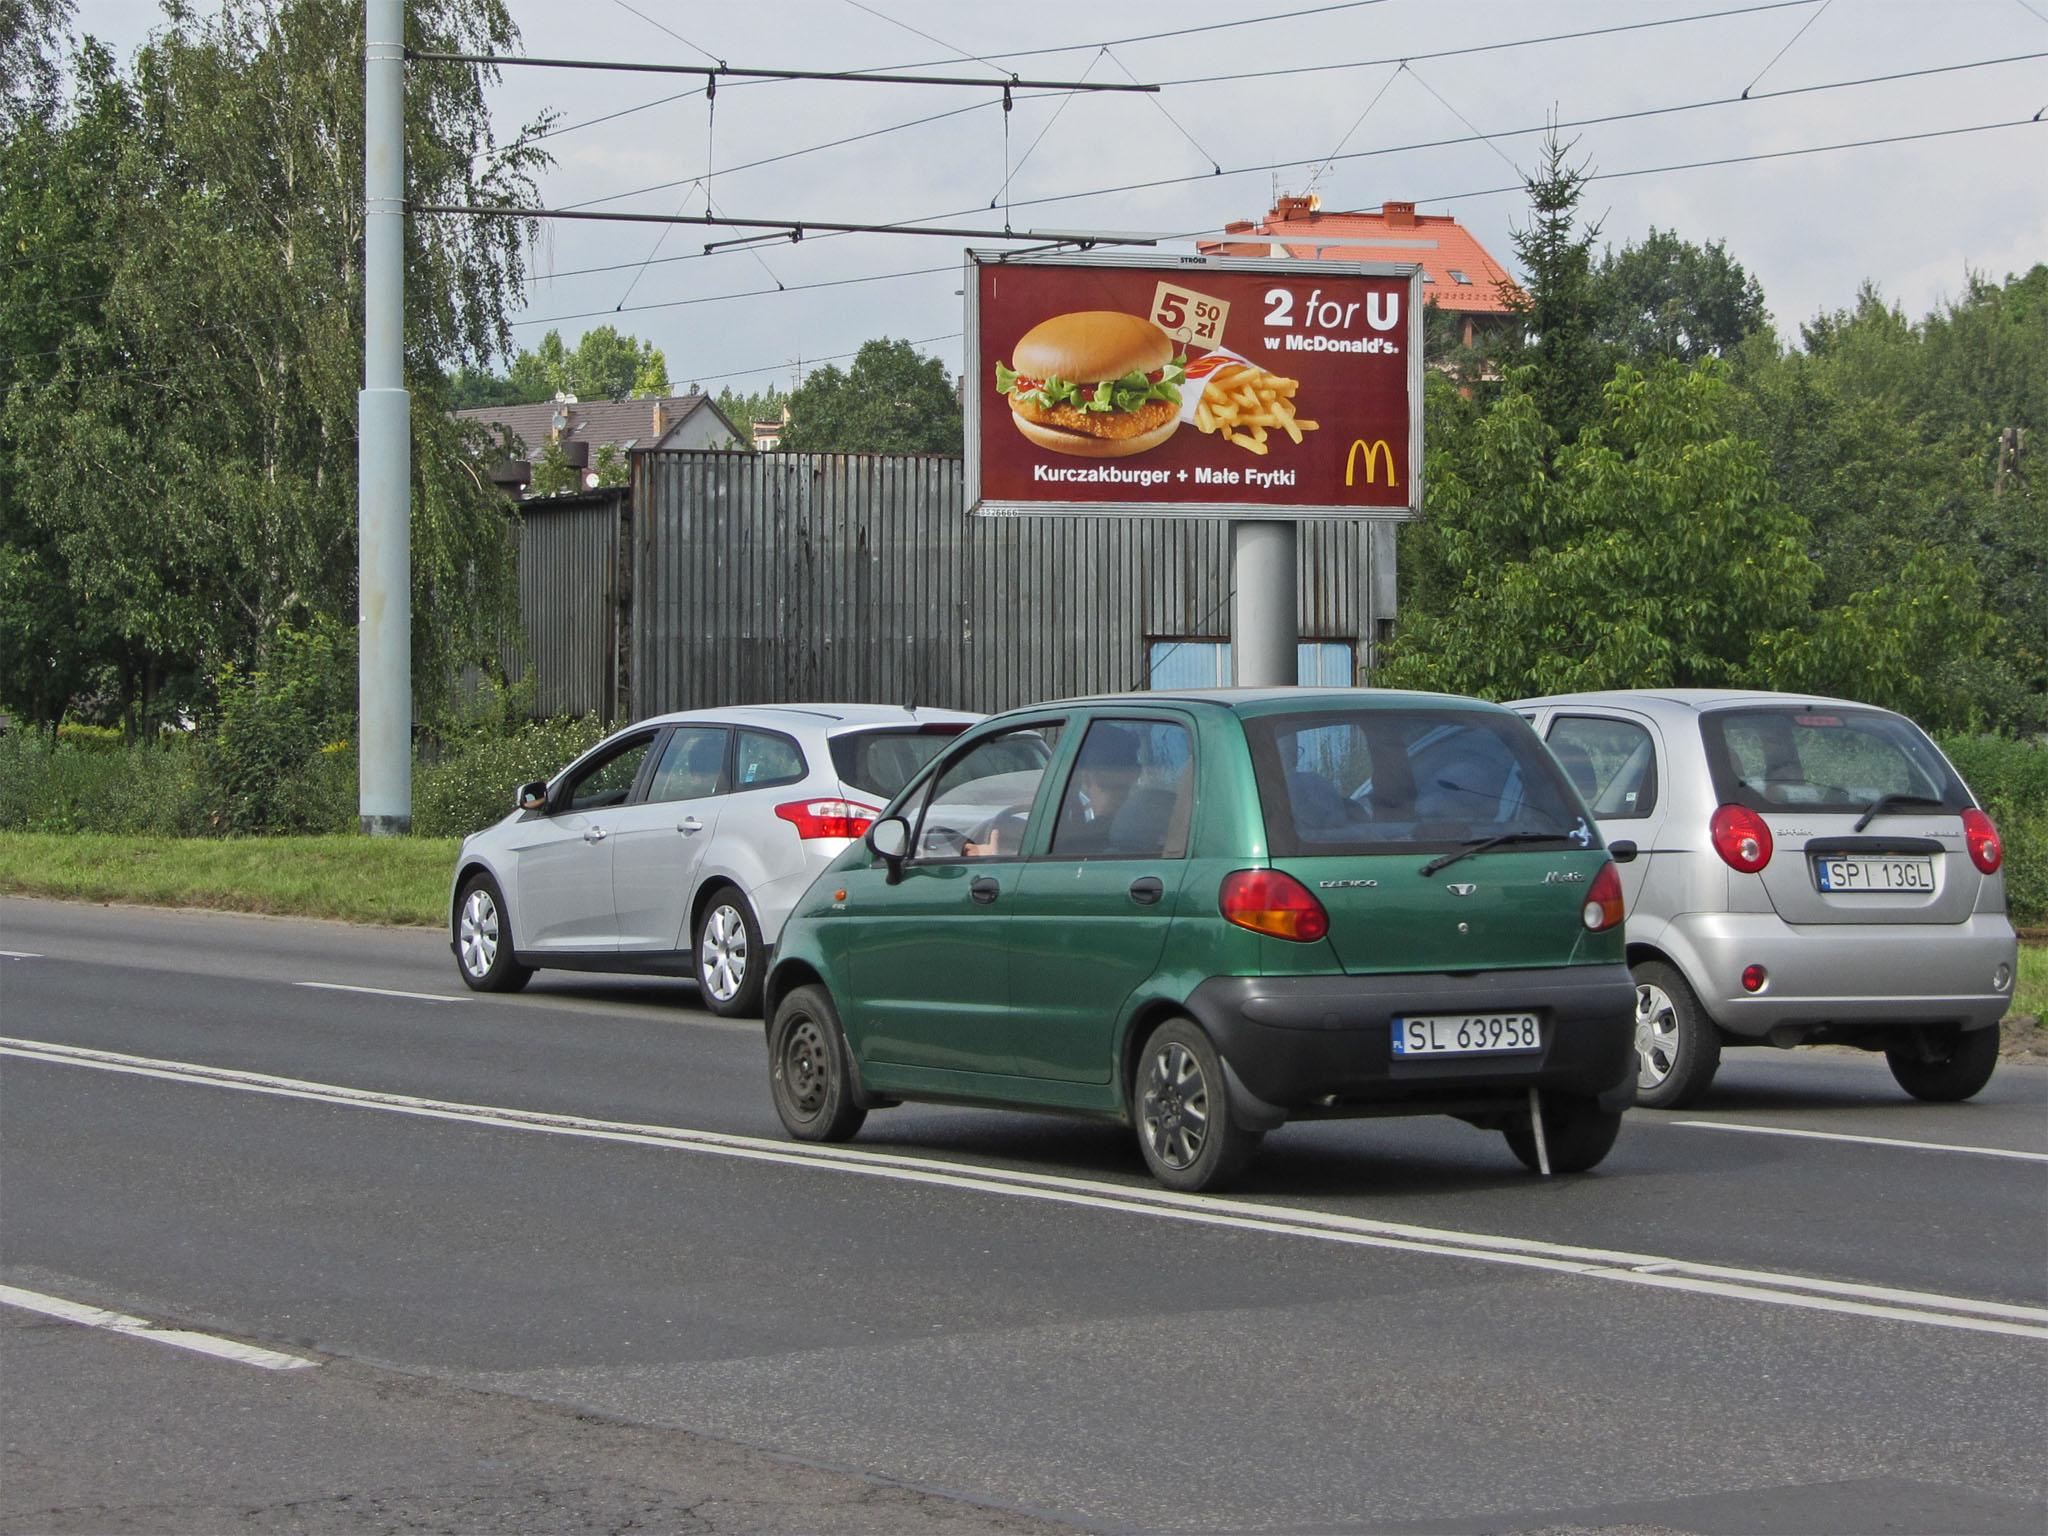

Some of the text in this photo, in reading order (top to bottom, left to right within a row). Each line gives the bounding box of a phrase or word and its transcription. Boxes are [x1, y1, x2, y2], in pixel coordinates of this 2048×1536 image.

[1157, 292, 1221, 329] 5 50
[1264, 288, 1399, 331] 2 for U
[1194, 322, 1217, 339] zł
[1264, 337, 1281, 350] w
[1034, 464, 1296, 489] Kurczakburger + Małe Frytki
[1831, 863, 1871, 887] SPI
[1882, 863, 1930, 887] 13GL
[1408, 1020, 1446, 1050] SL
[1457, 1017, 1535, 1048] 63958
